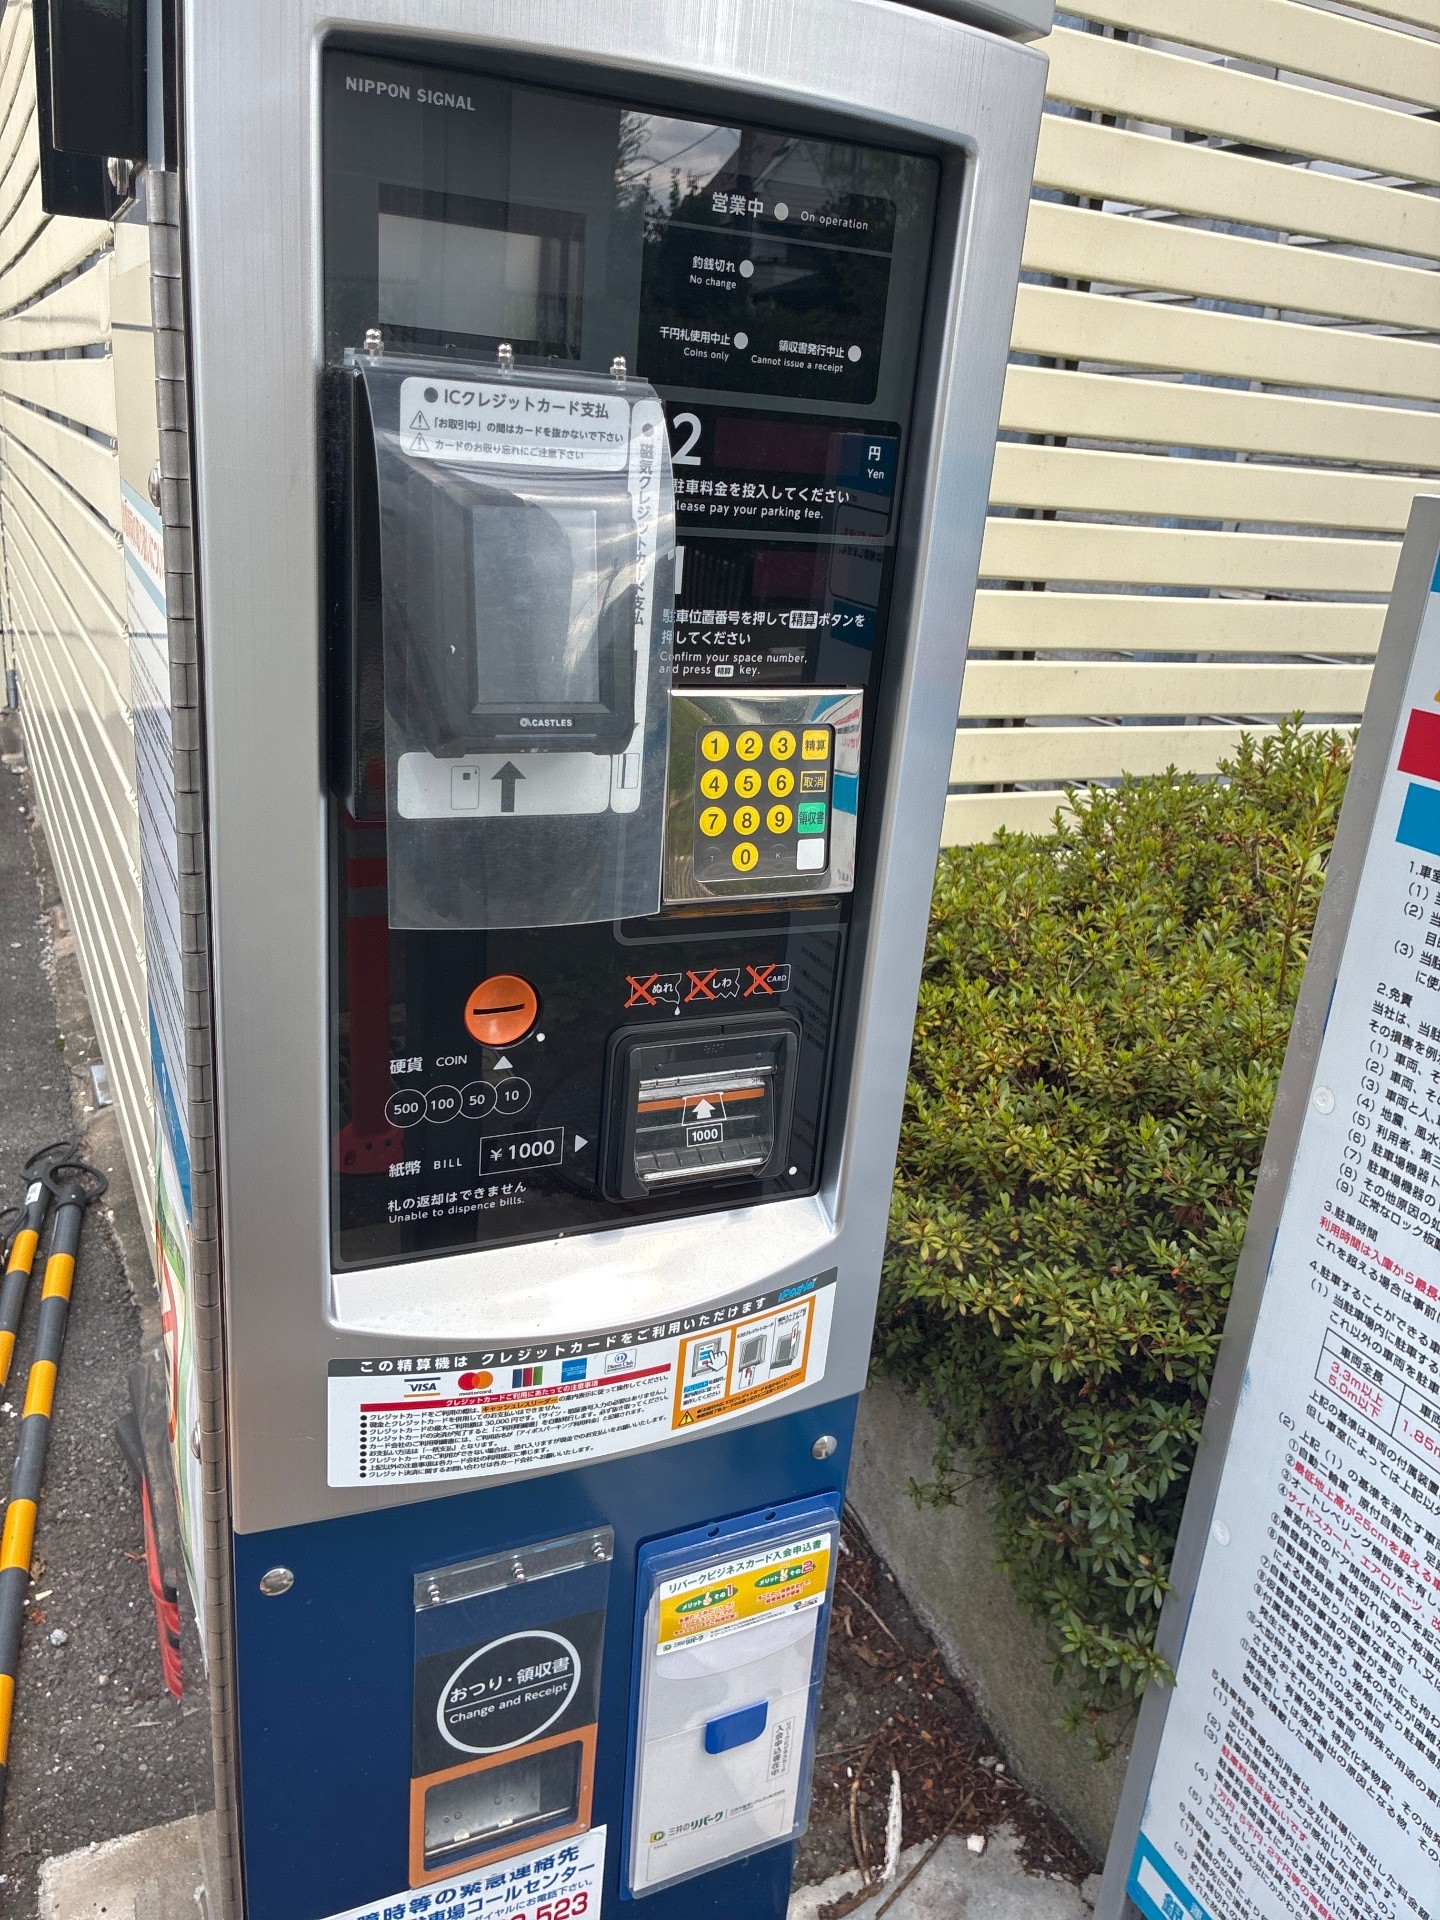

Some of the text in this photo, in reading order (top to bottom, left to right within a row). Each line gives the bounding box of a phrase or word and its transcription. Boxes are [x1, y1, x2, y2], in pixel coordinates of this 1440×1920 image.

[345, 76, 476, 112] NIPPON SIGNAL
[712, 191, 764, 219] 営業中
[800, 210, 869, 231] On operation
[692, 255, 736, 273] 釣銭切れ
[689, 275, 737, 291] No change
[659, 326, 731, 346] 千円札使用中止
[683, 347, 730, 363] Coins only
[778, 339, 845, 359] 領収書発行中止
[750, 355, 781, 366] Cannot
[783, 358, 805, 369] issue
[814, 361, 844, 374] receipt
[444, 387, 609, 419] ICクレジットカード支払
[672, 412, 702, 466] 2
[435, 438, 584, 461] カードのお取り忘れにご注意下さい
[868, 445, 881, 462] 円
[867, 468, 885, 480] Yen
[672, 478, 850, 504] 駐車料金を投入してください
[672, 499, 824, 520] lease pay your parking fee.
[661, 630, 751, 645] 押してください
[659, 651, 808, 665] Confirm your space number,
[659, 664, 679, 675] and
[682, 664, 711, 677] press
[739, 665, 761, 677] key.
[532, 719, 573, 727] CASTLES
[711, 737, 826, 754] 1 2 3 精算
[708, 774, 826, 792] 4 5 6 取消
[708, 811, 824, 830] 7 8 9 領収書
[740, 849, 750, 865] 0
[1408, 881, 1429, 901] (1)
[1403, 901, 1424, 920] (2)
[1394, 940, 1414, 959] (3)
[651, 982, 674, 994] ぬれ
[712, 976, 732, 989] しわ
[766, 974, 787, 983] CARD
[1376, 982, 1413, 1008] 2.免責
[1368, 1019, 1440, 1064] その損害を例
[1369, 1039, 1389, 1059] (1)
[389, 1054, 468, 1075] 硬貨 COIN
[1365, 1057, 1384, 1077] (2)
[1361, 1075, 1380, 1095] (3)
[393, 1090, 520, 1115] 500 100 50 10
[1356, 1093, 1375, 1112] (4)
[1352, 1111, 1371, 1130] (5)
[691, 1128, 719, 1142] 1000
[1348, 1128, 1366, 1147] (6)
[1343, 1145, 1362, 1165] (7)
[388, 1159, 421, 1178] 紙幣
[433, 1157, 463, 1171] BILL
[1339, 1162, 1358, 1181] (8)
[388, 1181, 527, 1213] 札の返却はできません
[1335, 1177, 1354, 1197] (9)
[388, 1196, 525, 1224] Unable to dispence bills.
[1323, 1200, 1379, 1242] 3.駐車時間
[1319, 1215, 1440, 1302] 利用時間は入庫から最長
[1310, 1278, 1328, 1298] (1)
[1315, 1233, 1440, 1324] これを超える場合は事前
[360, 1297, 767, 1373] この精算機は クレジットカードをご利用いただけます
[1340, 1345, 1384, 1386] 車両全長
[409, 1382, 437, 1392] VISA
[1331, 1360, 1383, 1408] 3.3m以上
[1327, 1374, 1381, 1418] 5.0m以下
[1278, 1411, 1296, 1431] (2)
[669, 1539, 822, 1594] リパークビジネスカード入会申込書
[450, 1656, 570, 1703] おつり・領収書
[449, 1681, 568, 1725] Change and Receipt
[668, 1811, 724, 1836] 三井のリパーク
[410, 1864, 596, 1920] 車場コールセンター
